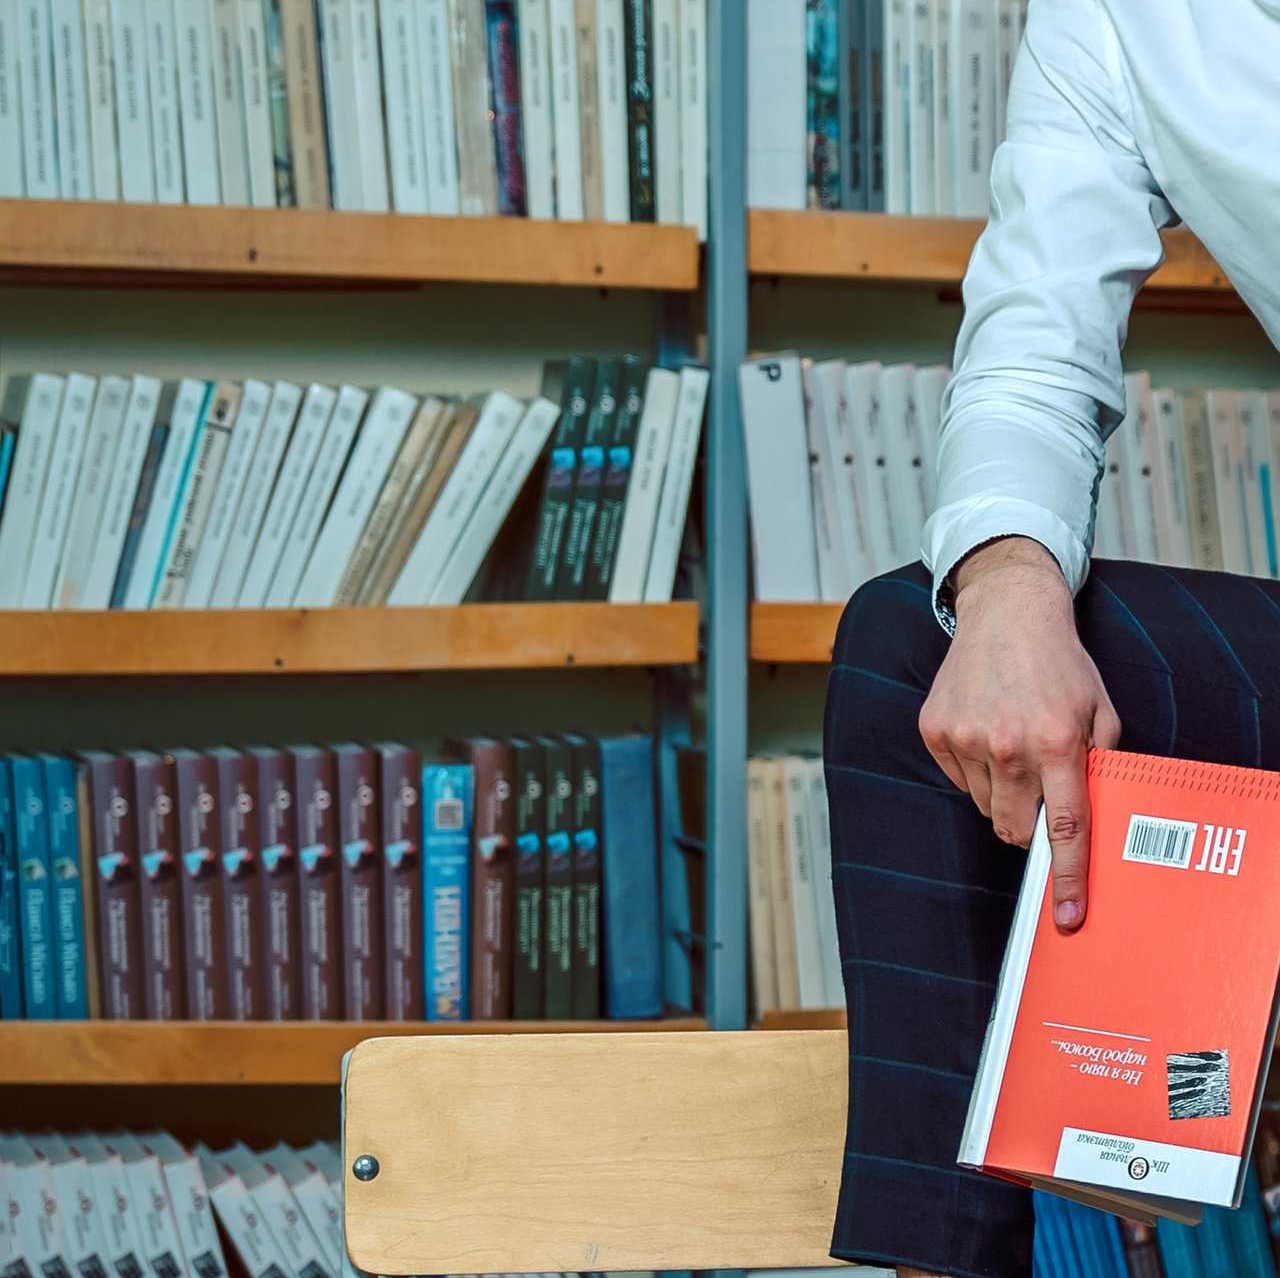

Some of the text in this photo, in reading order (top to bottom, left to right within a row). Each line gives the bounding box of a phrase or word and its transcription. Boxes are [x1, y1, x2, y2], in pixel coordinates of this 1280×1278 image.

[1102, 1047, 1148, 1066] народ
[1079, 1062, 1110, 1076] пяю
[1111, 1067, 1123, 1079] я
[1121, 1069, 1143, 1085] Не
[1076, 1134, 1135, 1154] бібліятэка
